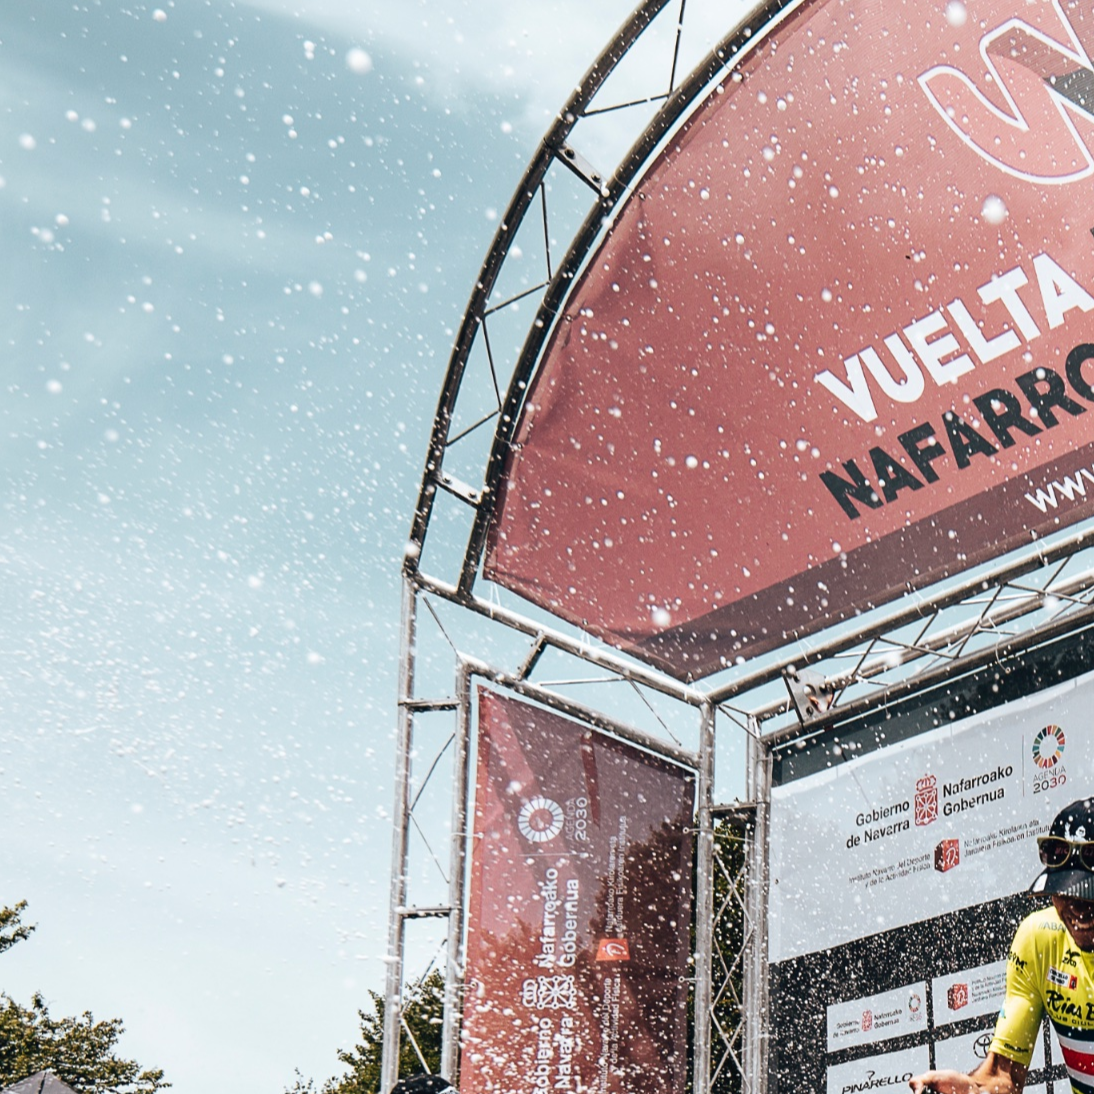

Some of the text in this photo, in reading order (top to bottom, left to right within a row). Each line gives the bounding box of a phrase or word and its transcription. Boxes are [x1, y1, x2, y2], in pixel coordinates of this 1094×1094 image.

[943, 766, 1013, 798] Nafarroako
[1034, 775, 1066, 794] 2030
[856, 801, 909, 826] Gobierno
[943, 787, 1005, 816] Gobernua
[575, 797, 588, 840] 2030
[846, 820, 910, 849] de Navarra
[539, 867, 558, 966] Nafarroako
[559, 879, 579, 966] Gobernua
[842, 1070, 913, 1094] PINARELLO
